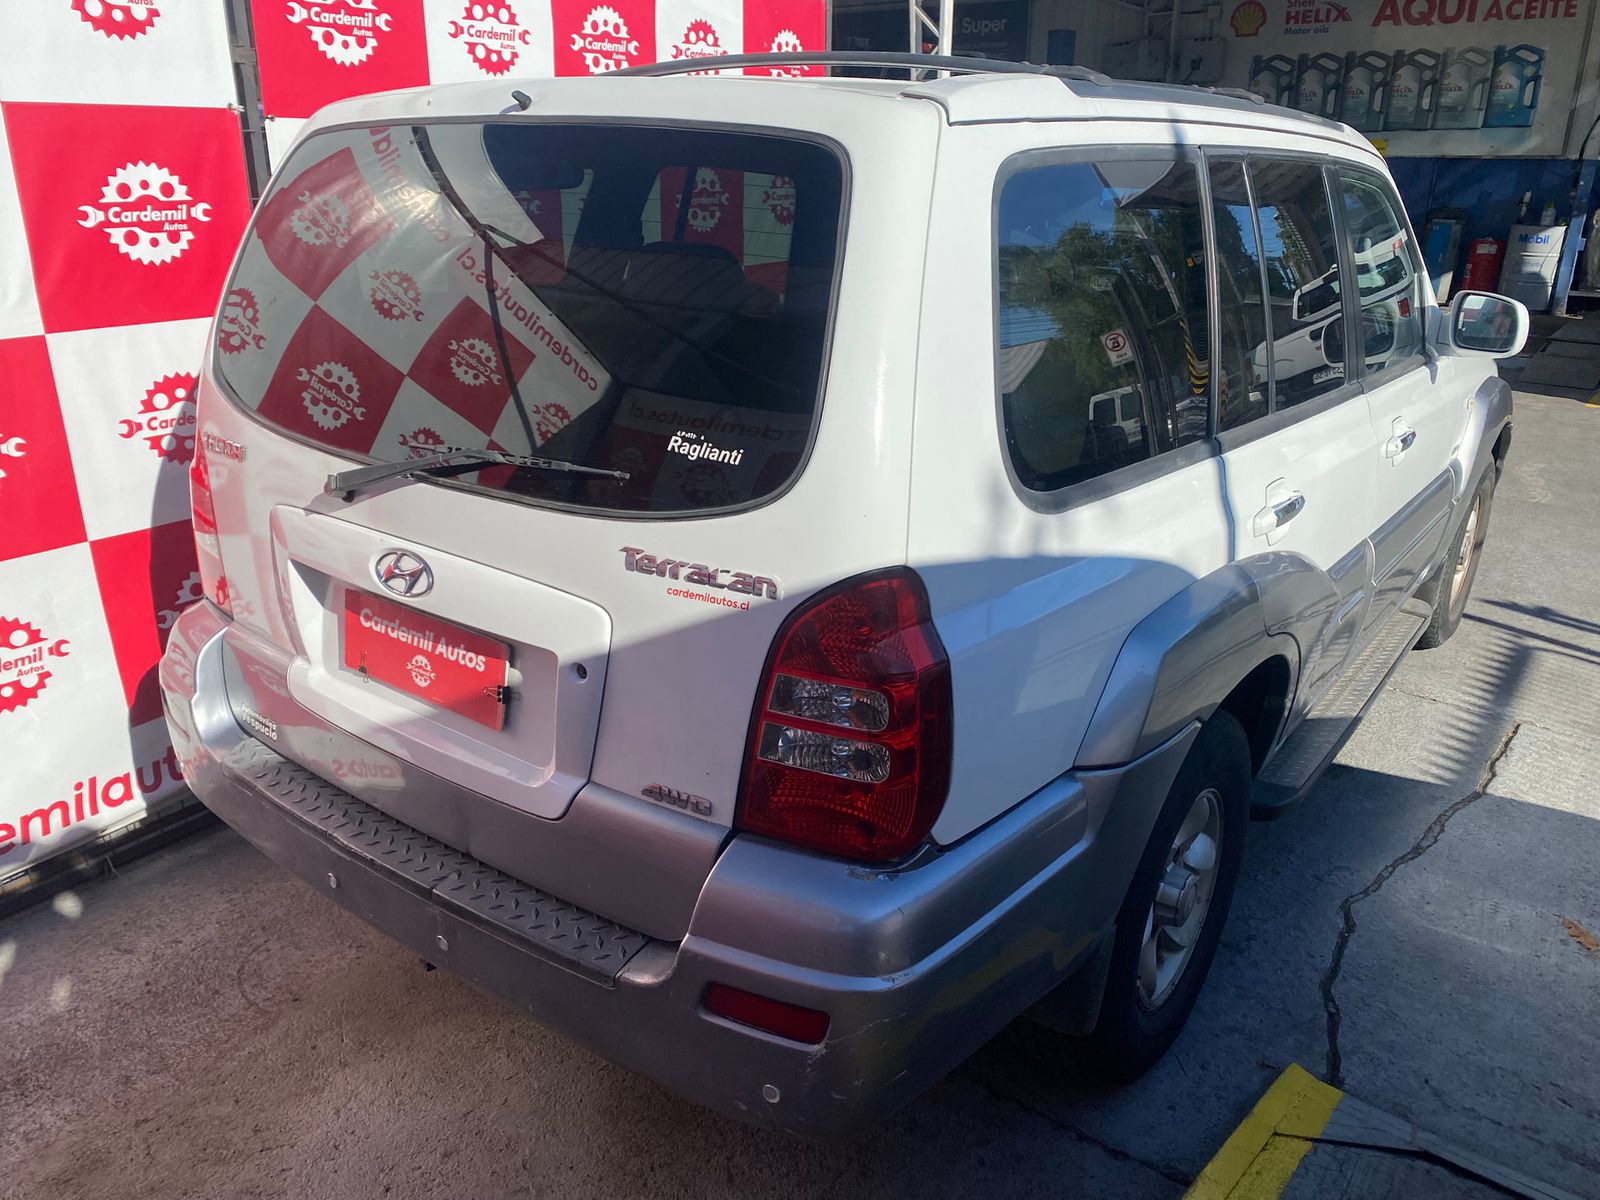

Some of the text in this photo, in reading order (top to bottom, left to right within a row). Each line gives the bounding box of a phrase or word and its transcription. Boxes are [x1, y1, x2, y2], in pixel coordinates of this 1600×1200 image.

[310, 8, 373, 27] Cardemil
[1286, 4, 1352, 25] HELIX
[1483, 0, 1579, 21] ACEITE
[352, 28, 373, 37] Autos
[467, 25, 516, 42] Cardemil
[962, 17, 1008, 36] Super
[1284, 24, 1329, 35] Motor oils
[500, 42, 516, 50] Autos
[585, 38, 627, 53] Cardemil
[108, 204, 188, 223] Cardemil
[163, 222, 188, 231] Autos
[1520, 233, 1550, 244] Mobil
[667, 435, 744, 465] Raglianti
[619, 546, 783, 601] Terracan
[666, 586, 750, 611] cardemilautos.cl
[359, 608, 487, 673] Cardemil Autos
[0, 646, 43, 672] emil
[16, 664, 45, 678] Autos
[641, 783, 713, 817] 4WD
